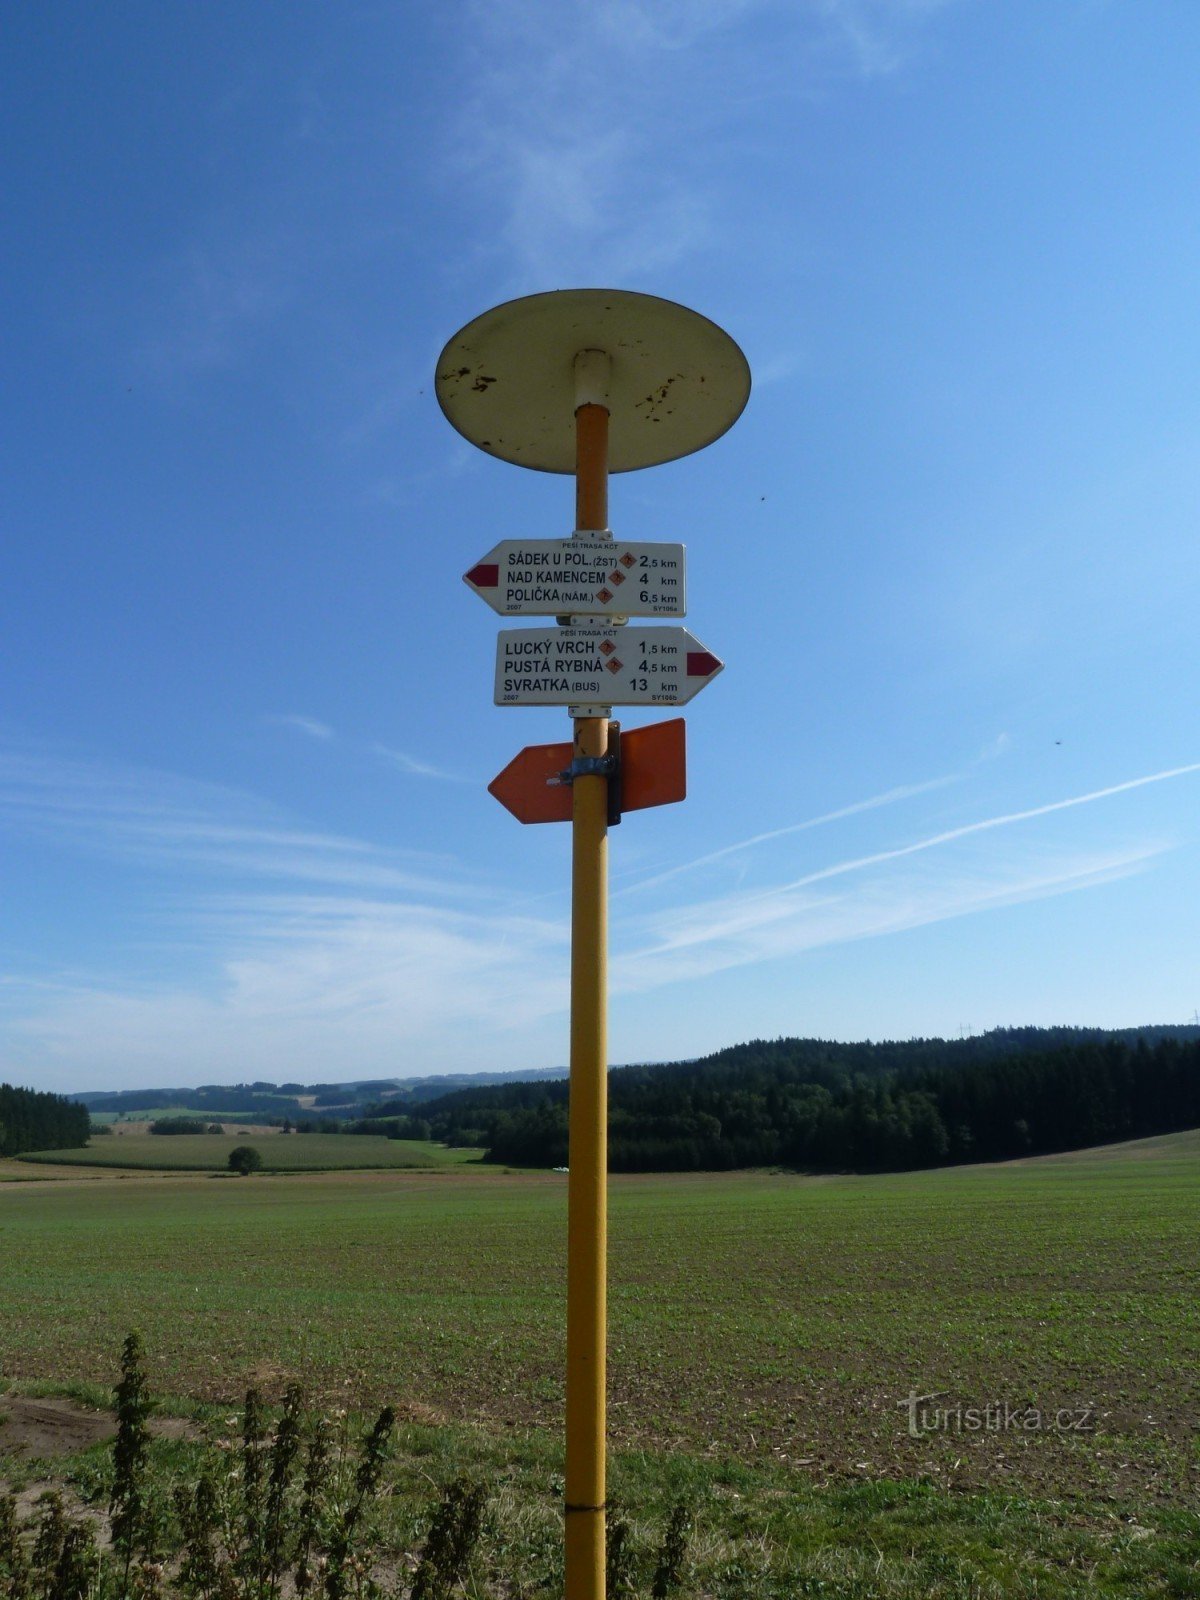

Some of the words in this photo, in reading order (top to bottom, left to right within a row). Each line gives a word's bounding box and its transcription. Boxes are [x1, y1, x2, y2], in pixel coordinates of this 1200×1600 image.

[508, 551, 549, 565] SÁDEK
[553, 554, 560, 564] U
[639, 556, 658, 568] 2,5
[661, 559, 677, 568] km
[507, 572, 532, 583] NAD
[537, 572, 605, 583] KAMENCEM
[639, 573, 648, 584] 4
[661, 577, 677, 585] km
[639, 591, 658, 603] 6,5
[661, 595, 677, 603] km
[505, 639, 552, 655] LUCKÝ
[556, 641, 594, 654] VRCH
[639, 641, 657, 655] 1,5
[661, 645, 677, 654] km
[505, 659, 550, 673] PUSTÁ
[555, 658, 603, 672] RYBNÁ
[639, 660, 657, 673] 4,5
[661, 664, 677, 672] km
[504, 679, 569, 691] SVRATKA
[572, 683, 600, 692] (BUS)
[630, 679, 648, 691] 13
[661, 683, 677, 691] km
